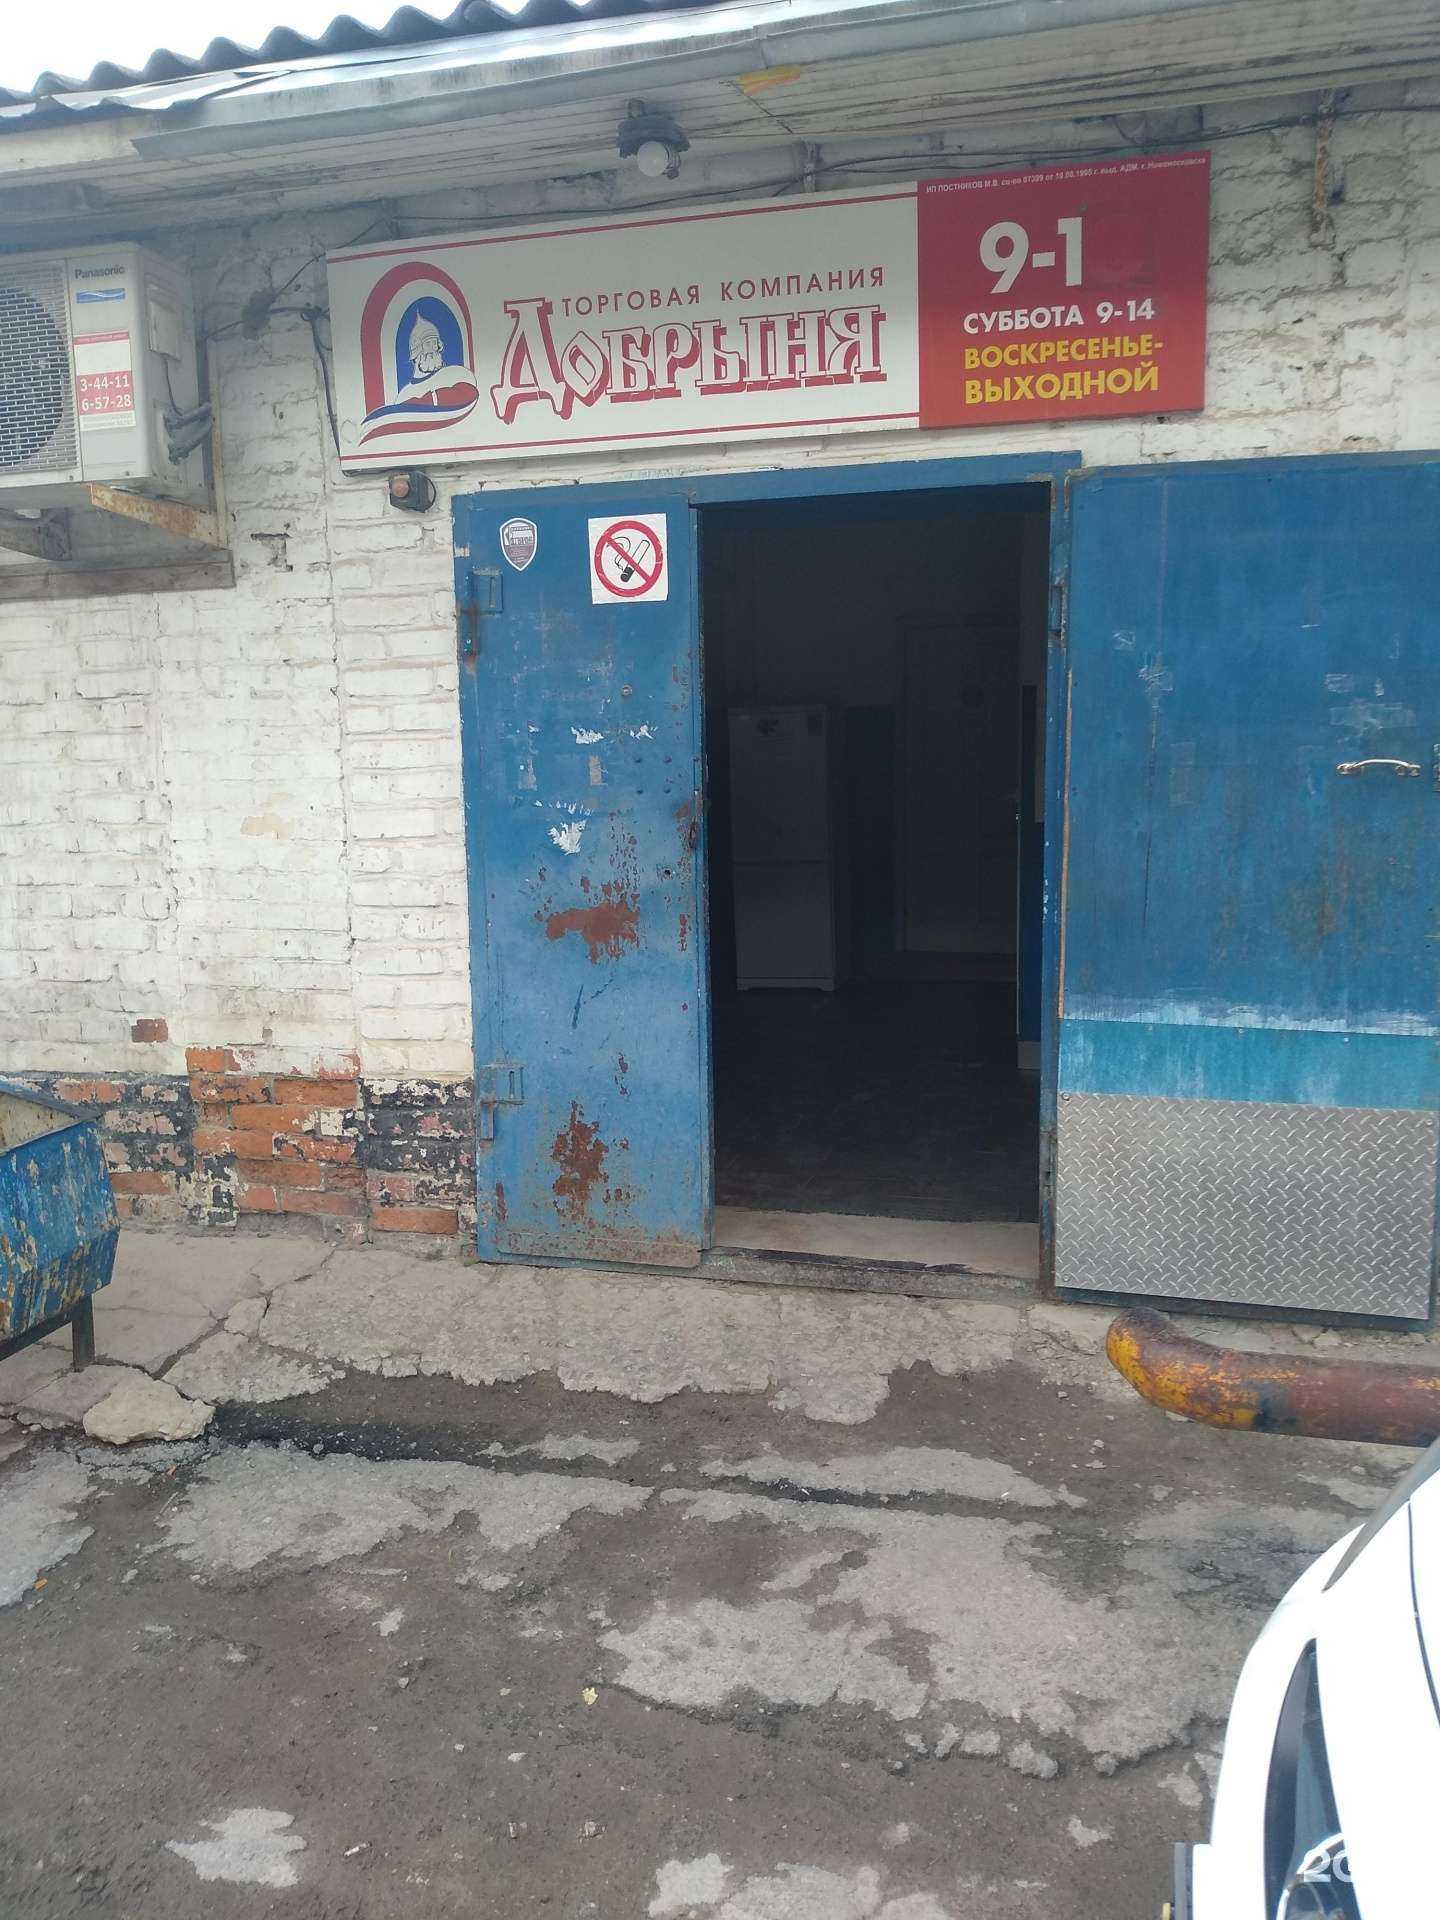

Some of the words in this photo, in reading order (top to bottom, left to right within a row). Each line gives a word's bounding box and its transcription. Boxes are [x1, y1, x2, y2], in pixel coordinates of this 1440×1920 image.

[74, 264, 125, 280] Panasonic
[561, 284, 700, 318] ТОРГОВАЯ
[720, 266, 885, 302] КОМПАНИЯ
[963, 304, 1084, 334] СУББОТА
[1096, 298, 1155, 324] 9-14
[490, 304, 888, 424] ДОБРЫНЯ
[964, 334, 1163, 369] ВОСКРЕСЕНЬЕ-
[80, 374, 130, 392] 3-44-11
[965, 360, 1159, 405] ВЫХОДНОЙ
[81, 394, 132, 411] 6-57-28
